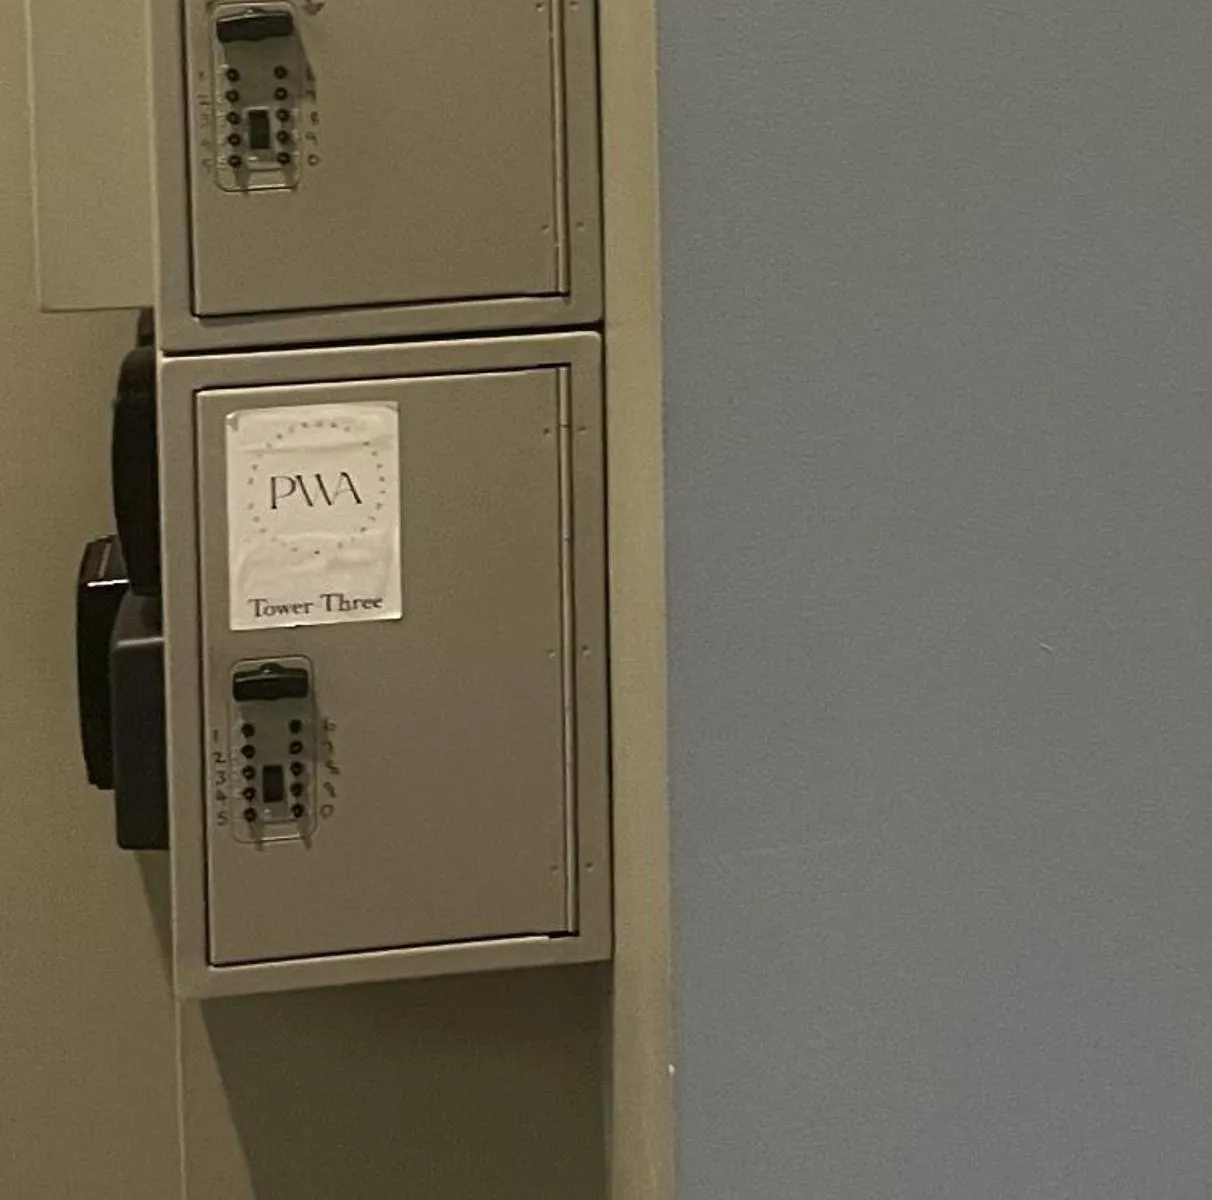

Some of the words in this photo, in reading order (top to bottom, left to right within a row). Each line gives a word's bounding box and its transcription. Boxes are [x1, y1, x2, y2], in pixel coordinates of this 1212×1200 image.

[270, 471, 362, 510] PWA
[248, 598, 314, 618] Tower
[319, 593, 383, 612] Three
